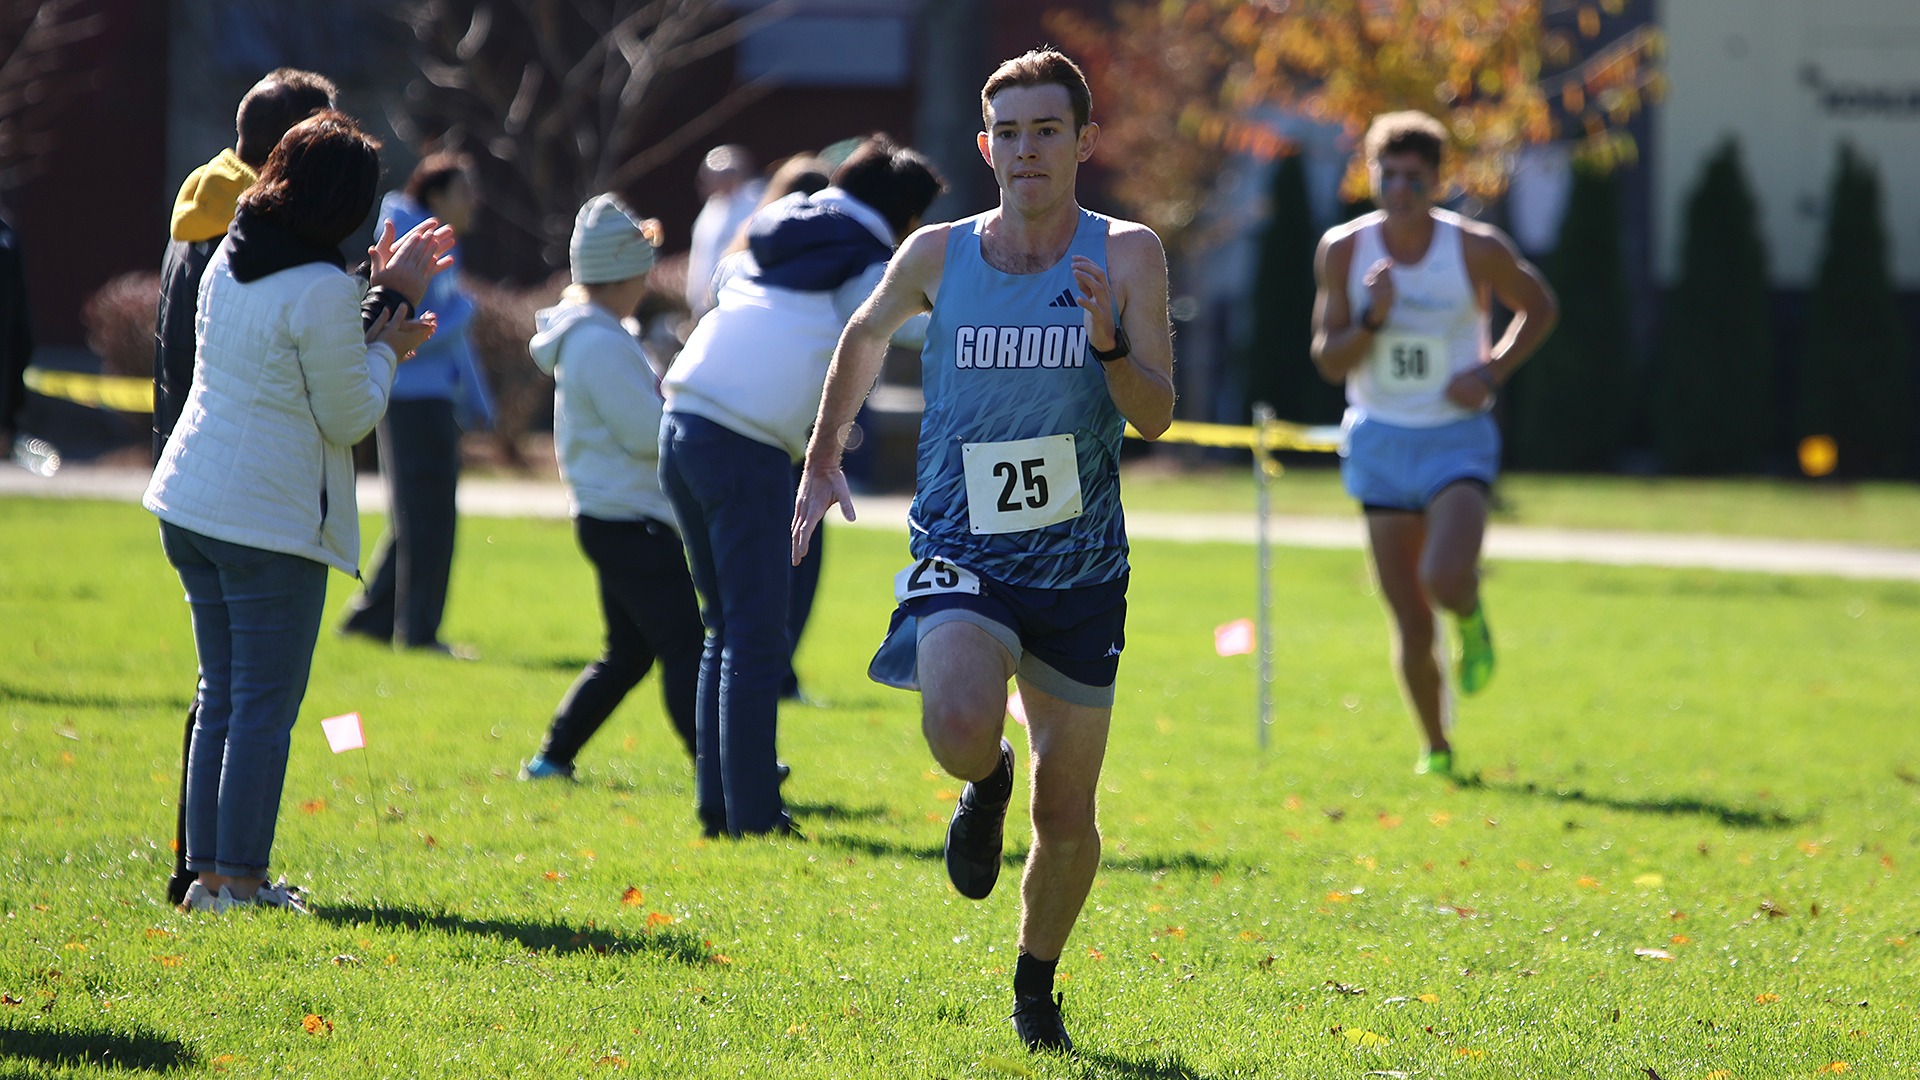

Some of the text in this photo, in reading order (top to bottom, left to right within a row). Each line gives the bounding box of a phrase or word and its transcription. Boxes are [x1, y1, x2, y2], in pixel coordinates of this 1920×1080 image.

[955, 325, 1087, 369] GORDON
[993, 458, 1049, 512] 25
[907, 557, 960, 593] 25
